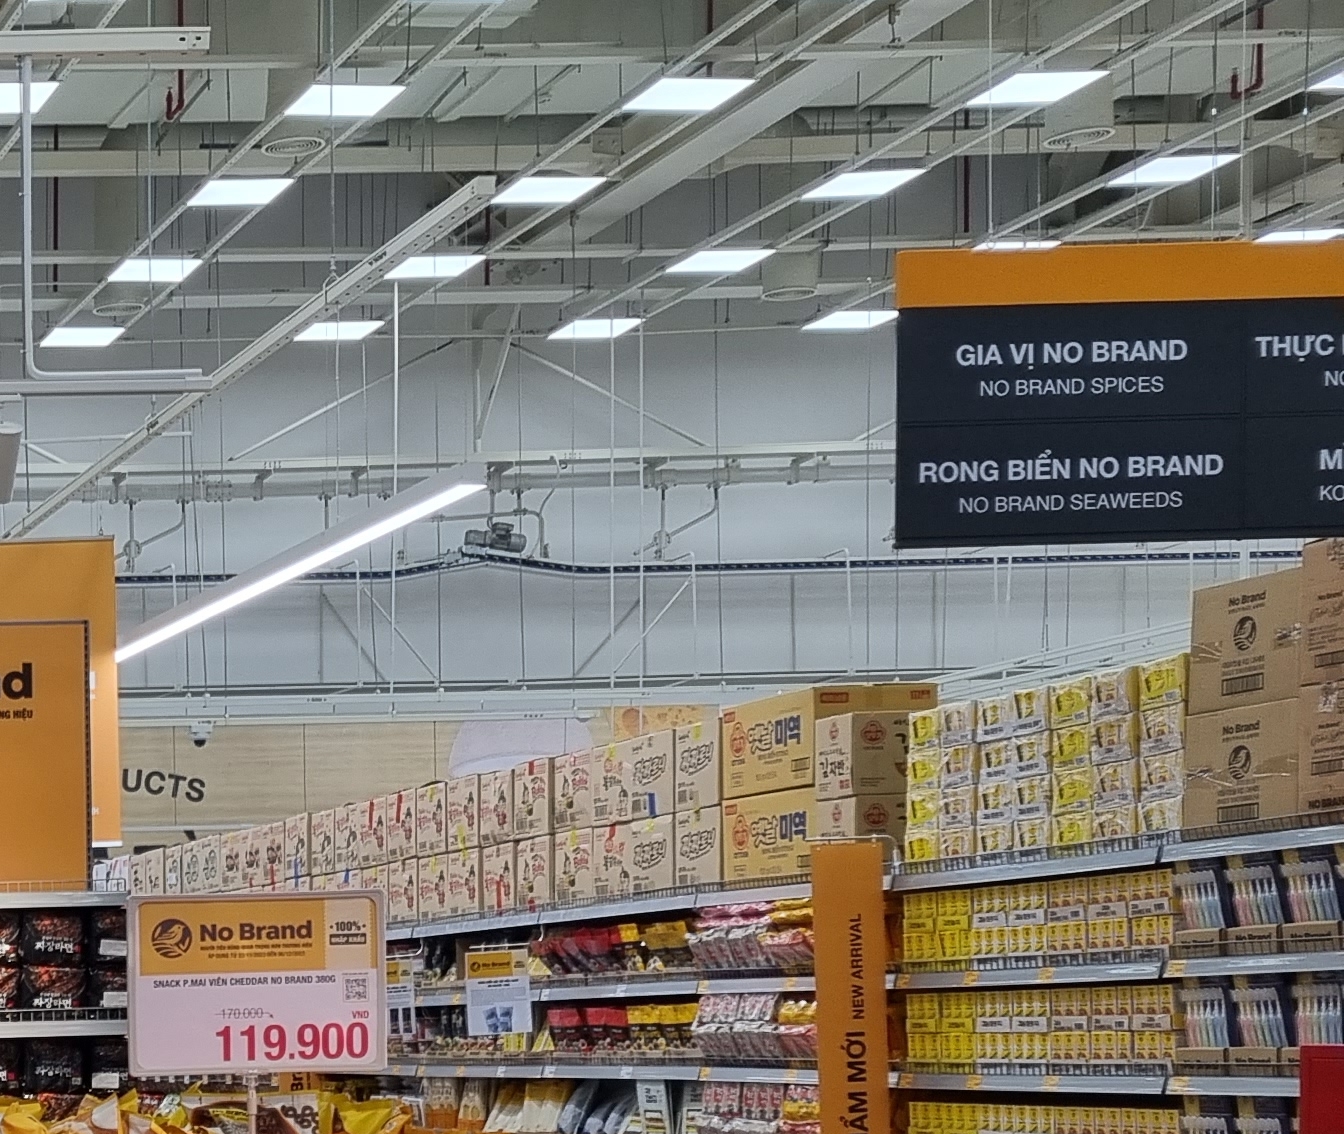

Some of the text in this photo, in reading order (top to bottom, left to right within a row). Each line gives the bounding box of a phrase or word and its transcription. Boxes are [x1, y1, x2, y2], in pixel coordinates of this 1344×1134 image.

[956, 339, 1188, 370] GIA VỊ NO BRAND
[1255, 334, 1335, 362] THỰC
[980, 376, 1164, 397] NO BRAND SPICES
[919, 448, 1224, 484] RONG BIỂN NO BRAND
[959, 491, 1183, 514] NO BRAND SEAWEEDS
[200, 920, 312, 942] No Brand
[334, 921, 361, 931] 100%
[849, 912, 865, 1020] NEW ARRIVAL
[153, 979, 181, 988] SNACK
[183, 978, 206, 988] P.MAI
[229, 977, 268, 986] CHEDDAR
[271, 976, 282, 985] NO
[285, 975, 313, 985] BRAND
[352, 1010, 370, 1019] VND
[215, 1022, 369, 1062] 119.900
[840, 1030, 867, 1082] MỚI
